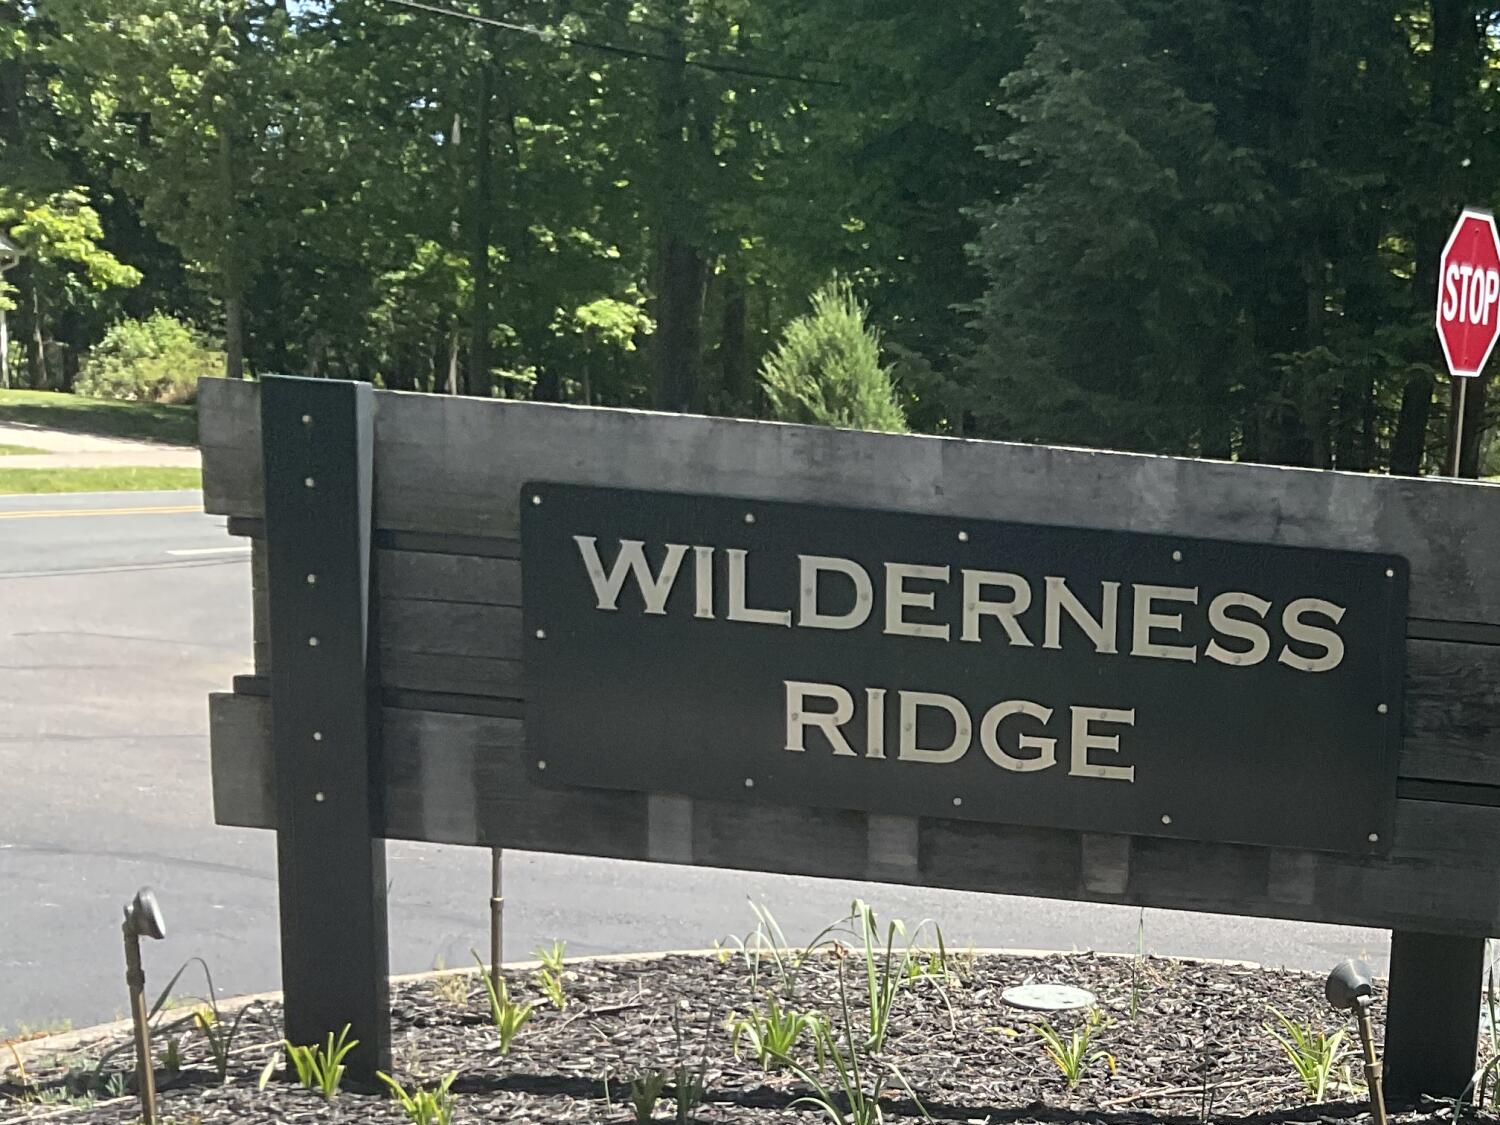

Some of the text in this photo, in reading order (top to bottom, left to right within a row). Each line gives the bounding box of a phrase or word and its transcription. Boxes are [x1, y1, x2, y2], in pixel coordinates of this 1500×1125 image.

[1442, 262, 1500, 325] STOP
[573, 535, 1347, 673] WILDERNESS
[783, 680, 1136, 783] RIDGE
